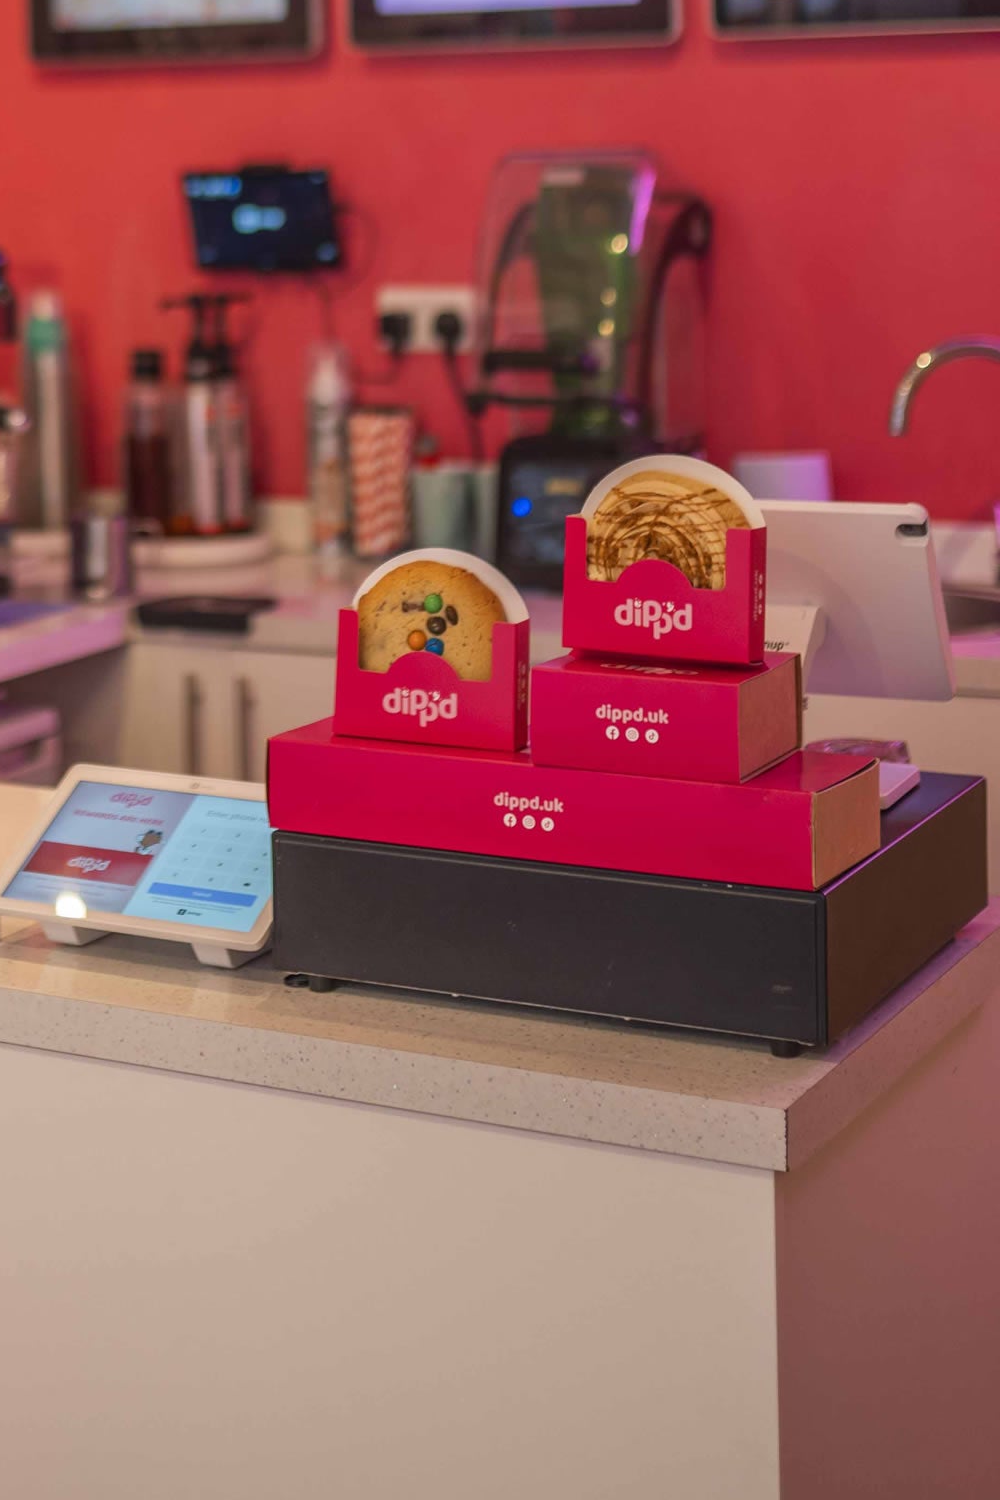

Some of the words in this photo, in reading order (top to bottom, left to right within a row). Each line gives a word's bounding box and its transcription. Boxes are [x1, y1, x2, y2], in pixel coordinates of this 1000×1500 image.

[613, 597, 693, 640] dippd
[382, 687, 458, 728] dippd
[595, 704, 669, 725] dippd.uk
[493, 791, 564, 812] dippd.uk
